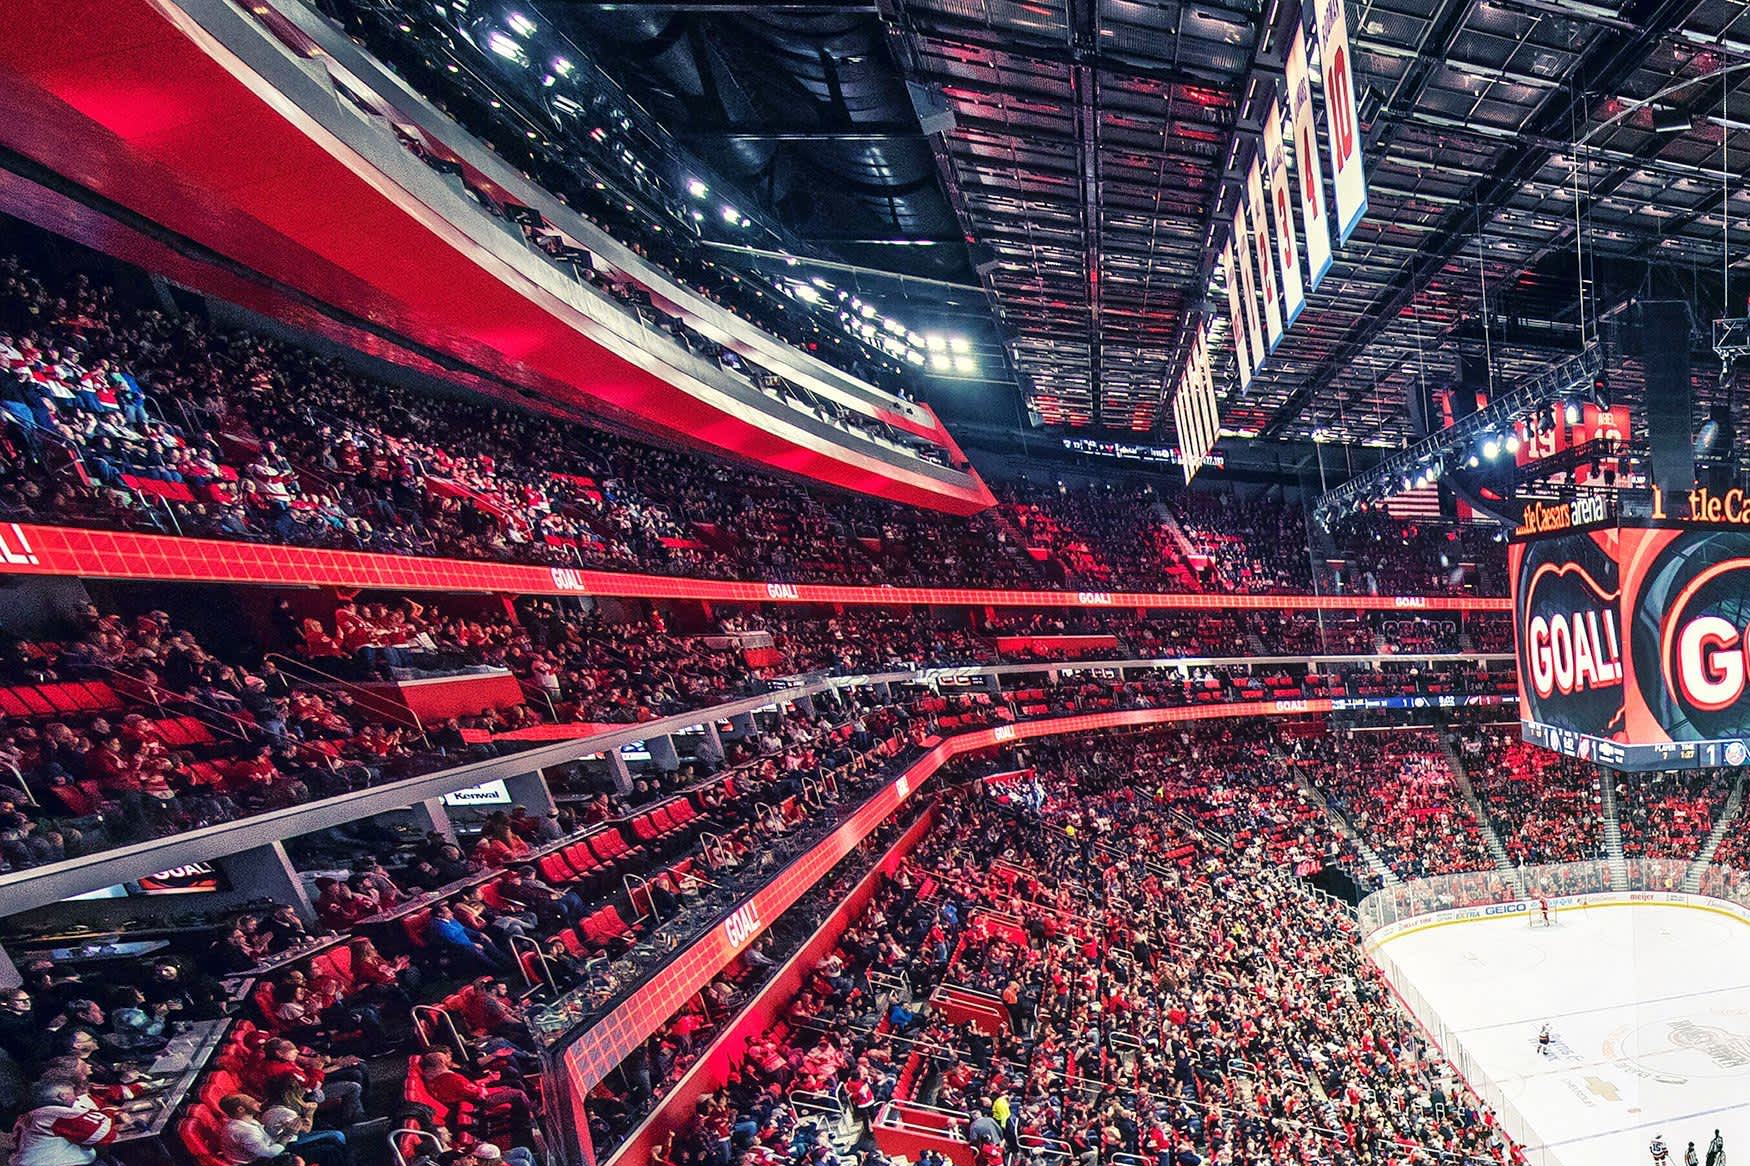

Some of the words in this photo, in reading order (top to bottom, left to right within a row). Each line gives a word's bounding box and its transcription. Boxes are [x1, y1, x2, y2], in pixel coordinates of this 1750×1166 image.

[1328, 46, 1352, 173] 10
[1536, 502, 1571, 533] Caesars
[1571, 496, 1604, 526] arena
[551, 567, 585, 590] GOAL!
[767, 583, 799, 600] GOAL!
[1079, 591, 1111, 604] GOAL!
[1395, 596, 1426, 608] GOAL!
[1530, 609, 1623, 698] GOAL!
[1276, 699, 1308, 711] GOAL!
[994, 725, 1015, 741] GOAL!
[1706, 744, 1715, 766] 1
[454, 790, 500, 800] Kenwal
[1485, 903, 1527, 915] GEICO
[724, 899, 759, 949] GOAL!
